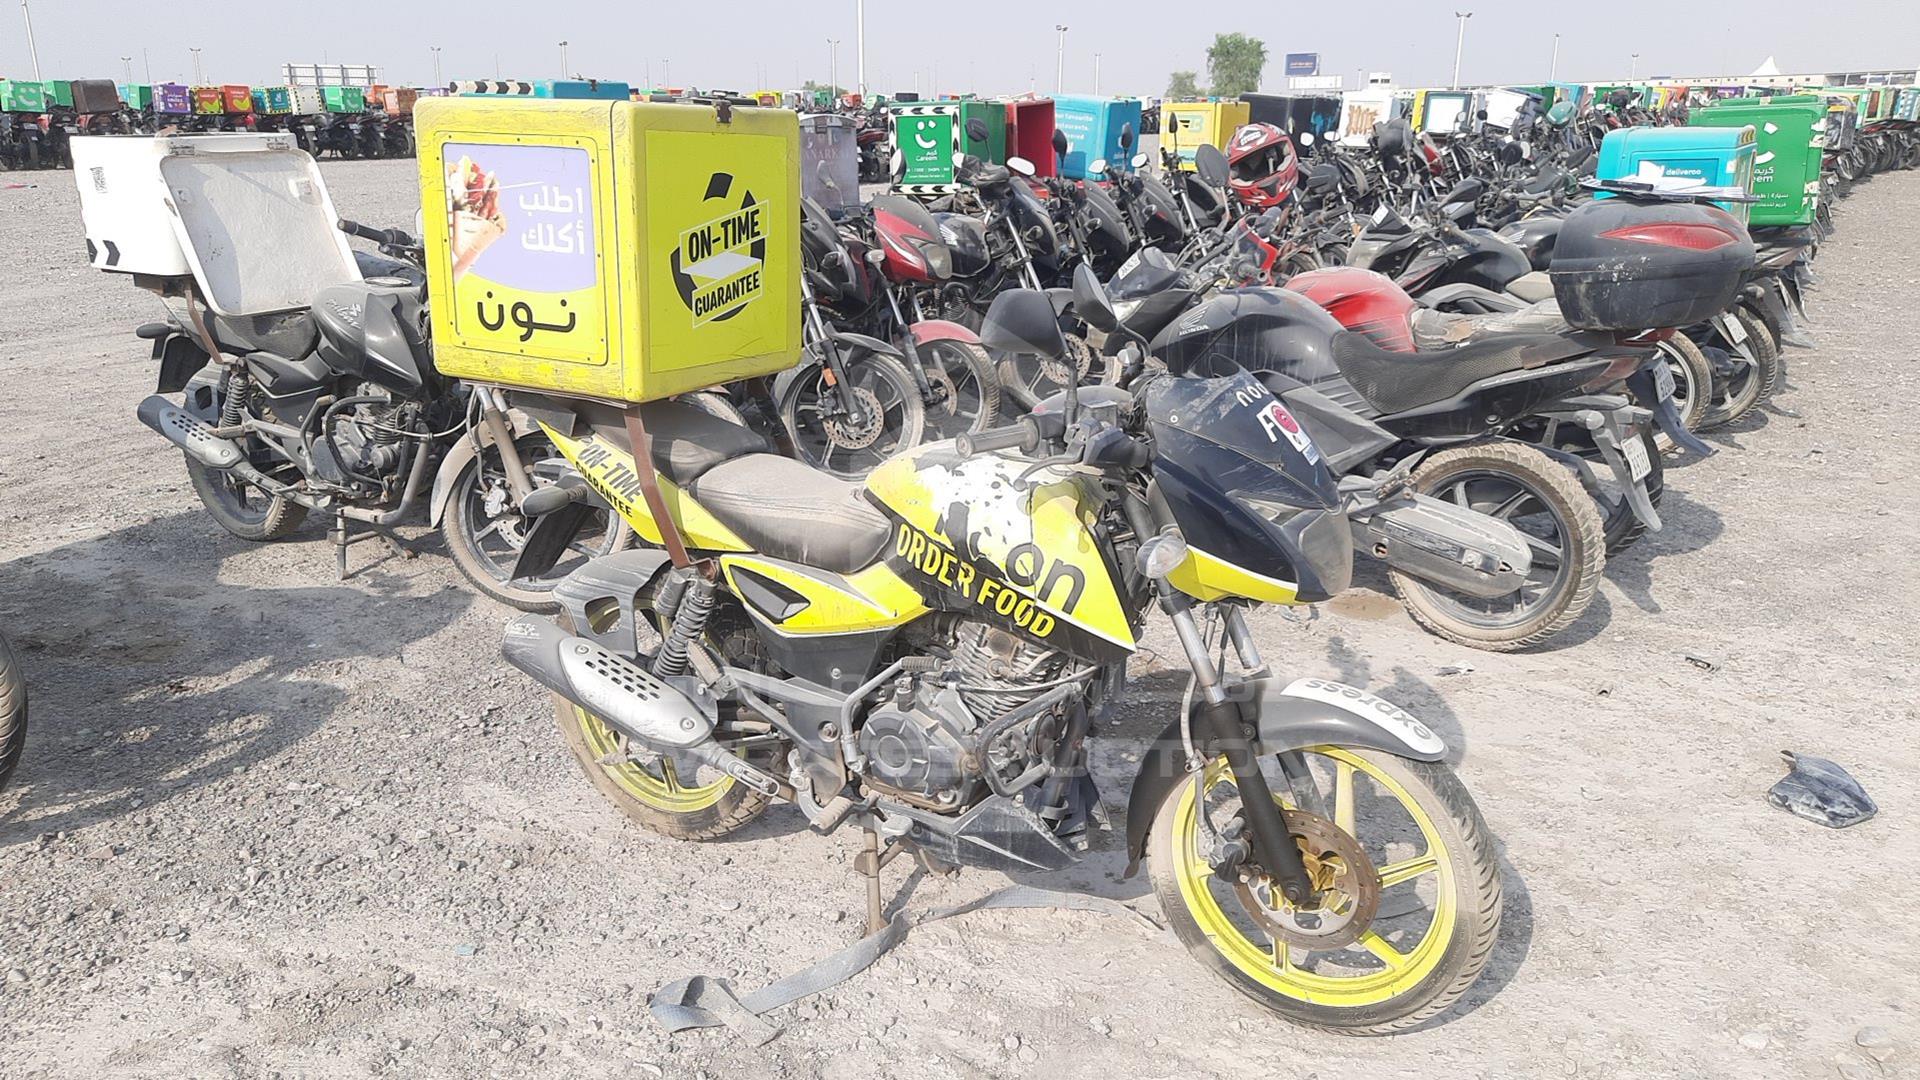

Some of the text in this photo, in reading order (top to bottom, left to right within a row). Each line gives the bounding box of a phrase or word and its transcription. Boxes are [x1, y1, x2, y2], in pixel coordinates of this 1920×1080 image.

[520, 185, 584, 217] اطلب
[521, 221, 585, 255] أكلك
[688, 208, 761, 263] ON-TIME
[477, 290, 576, 342] نون
[694, 270, 761, 318] GUARANTEE
[1178, 324, 1210, 337] HONDA
[575, 461, 633, 519] GUARANTEE
[577, 443, 641, 504] ON-TIME
[895, 522, 1057, 639] ORDER FOOD
[1305, 679, 1432, 740] express
